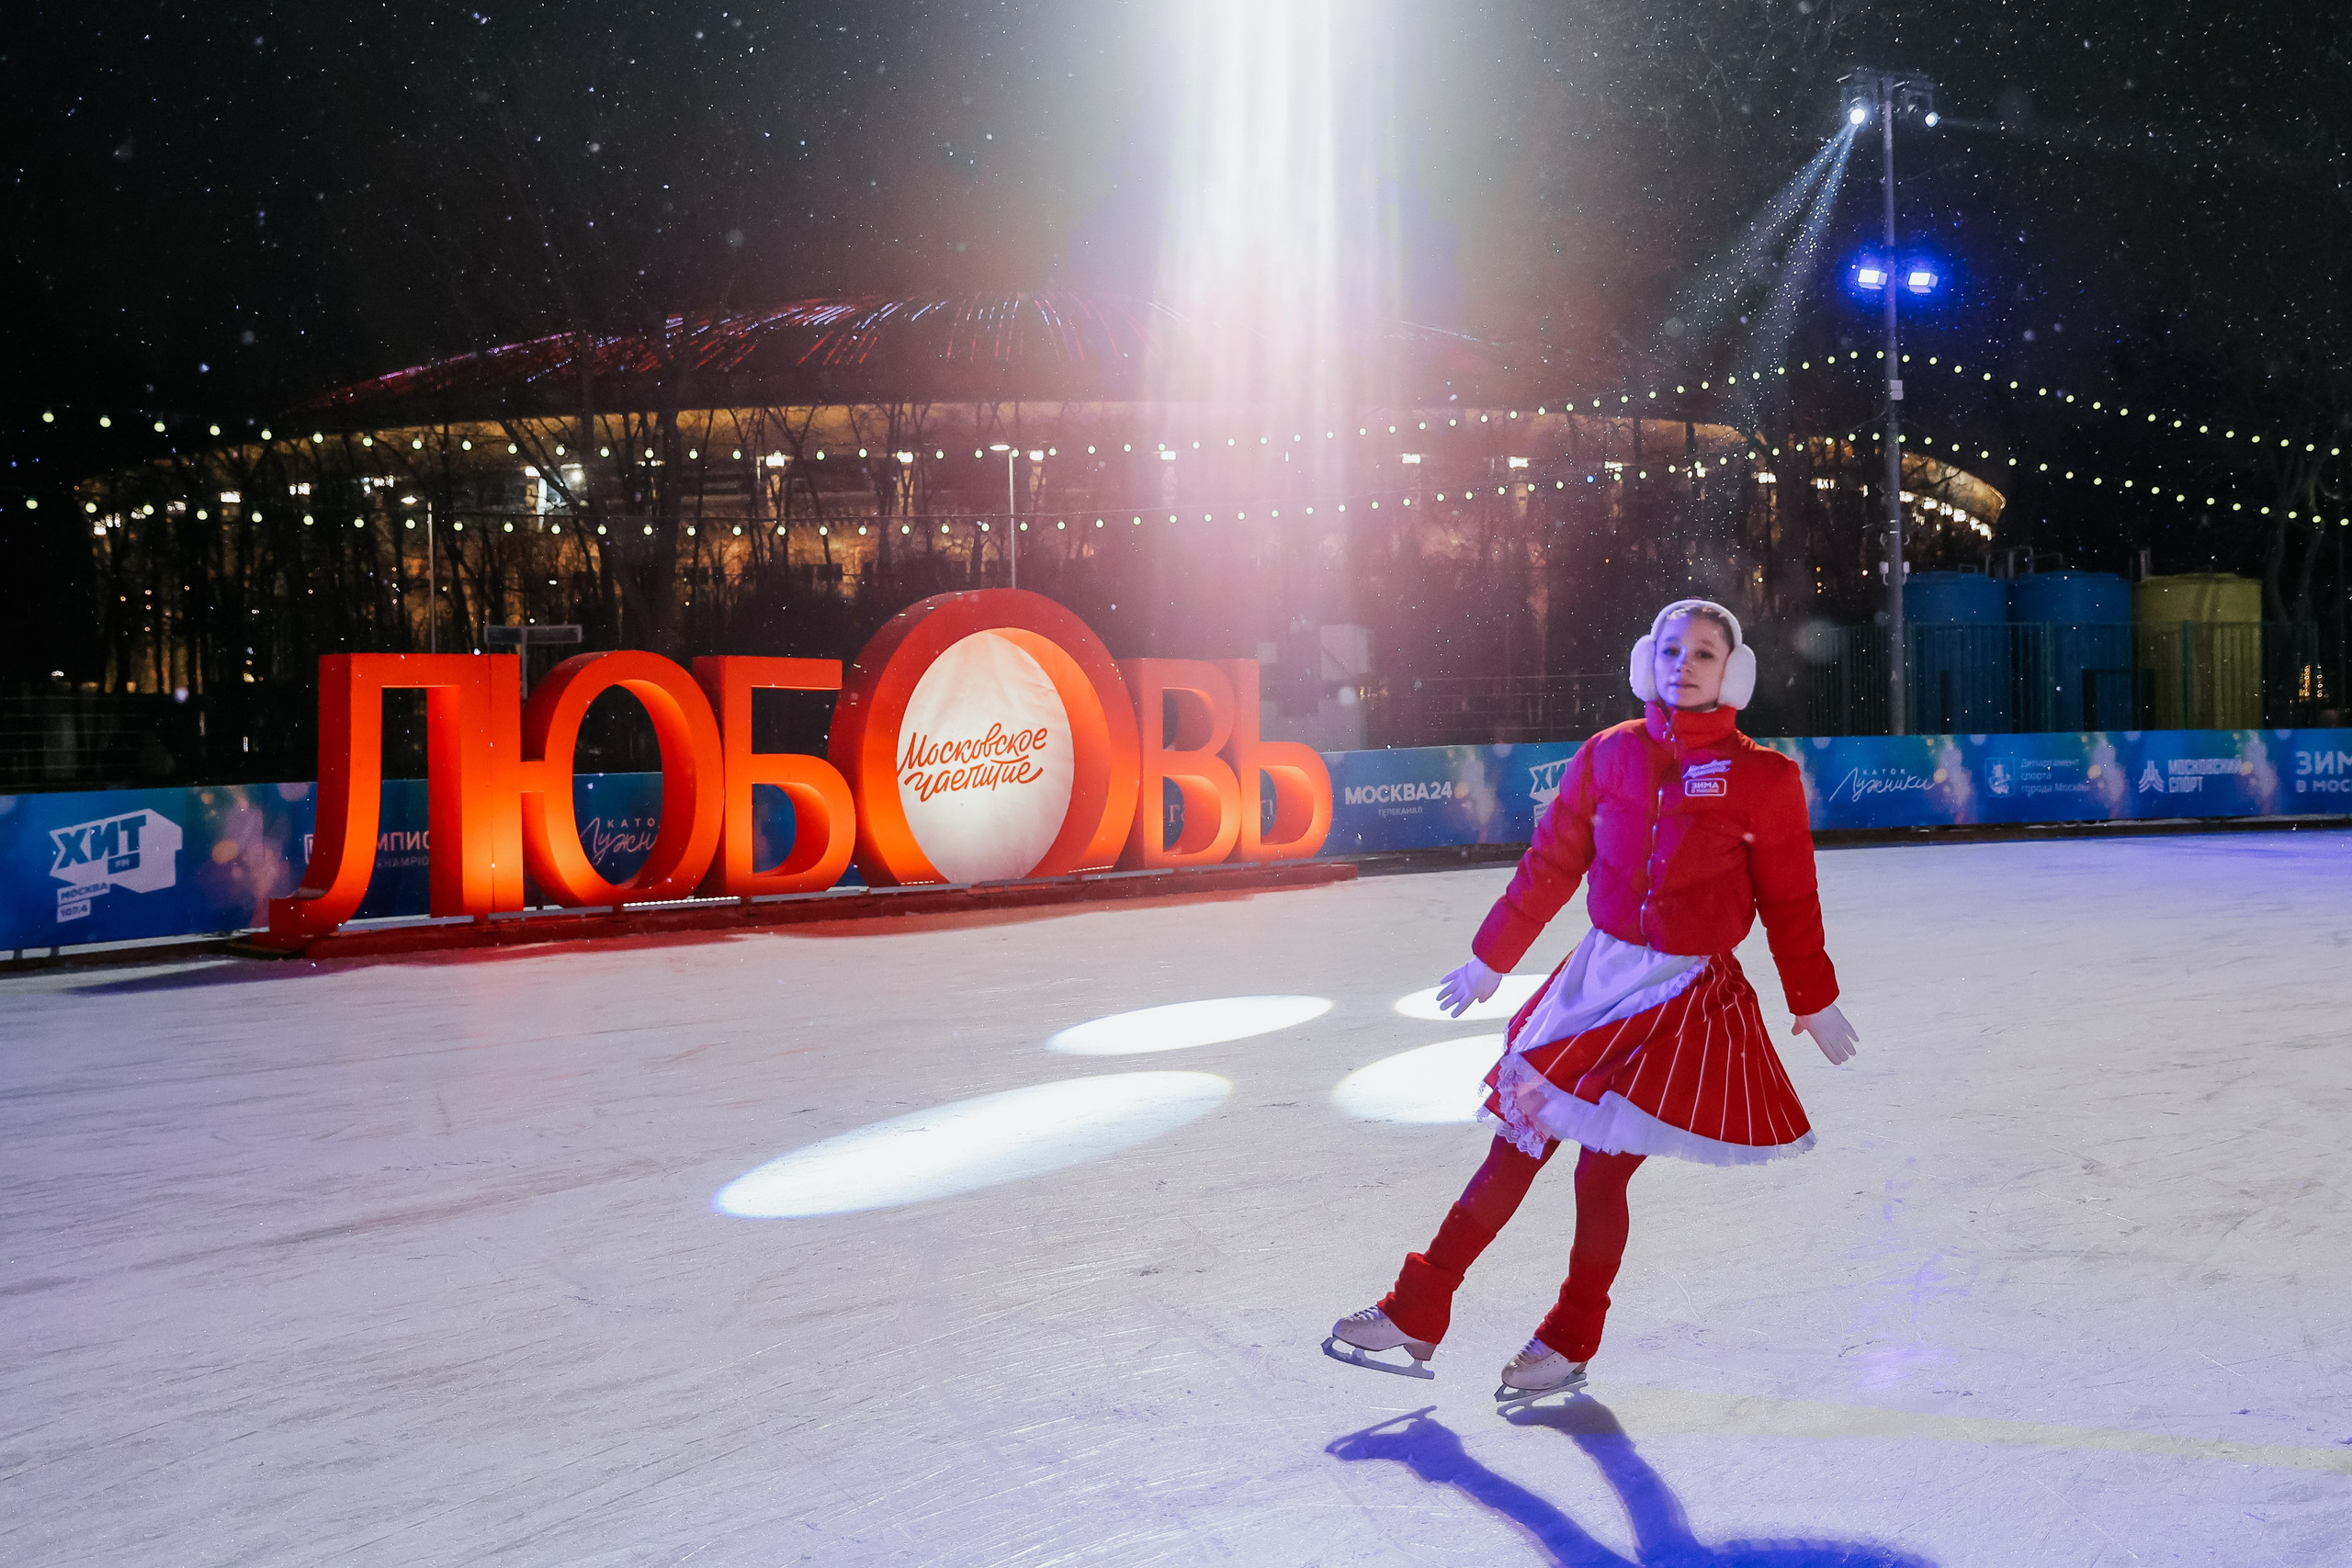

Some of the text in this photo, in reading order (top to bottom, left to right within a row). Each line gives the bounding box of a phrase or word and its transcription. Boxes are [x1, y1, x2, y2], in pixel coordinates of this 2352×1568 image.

[897, 723, 1047, 777] Московское
[269, 589, 1333, 941] ЛЮБОВЬ
[1533, 763, 1566, 793] ХИ
[1691, 781, 1719, 789] ЗИМА
[1829, 767, 1935, 802] Лужники
[2169, 776, 2203, 793] СПОРТ
[2312, 779, 2352, 793] МОС
[1345, 781, 1453, 805] МОСКВА24
[607, 818, 656, 828] КАТО
[1378, 807, 1423, 817] ТЕЛЕКАНАЛ
[57, 814, 147, 870] ХИТ
[581, 818, 657, 865] Лужн
[61, 882, 107, 900] МОСКВА
